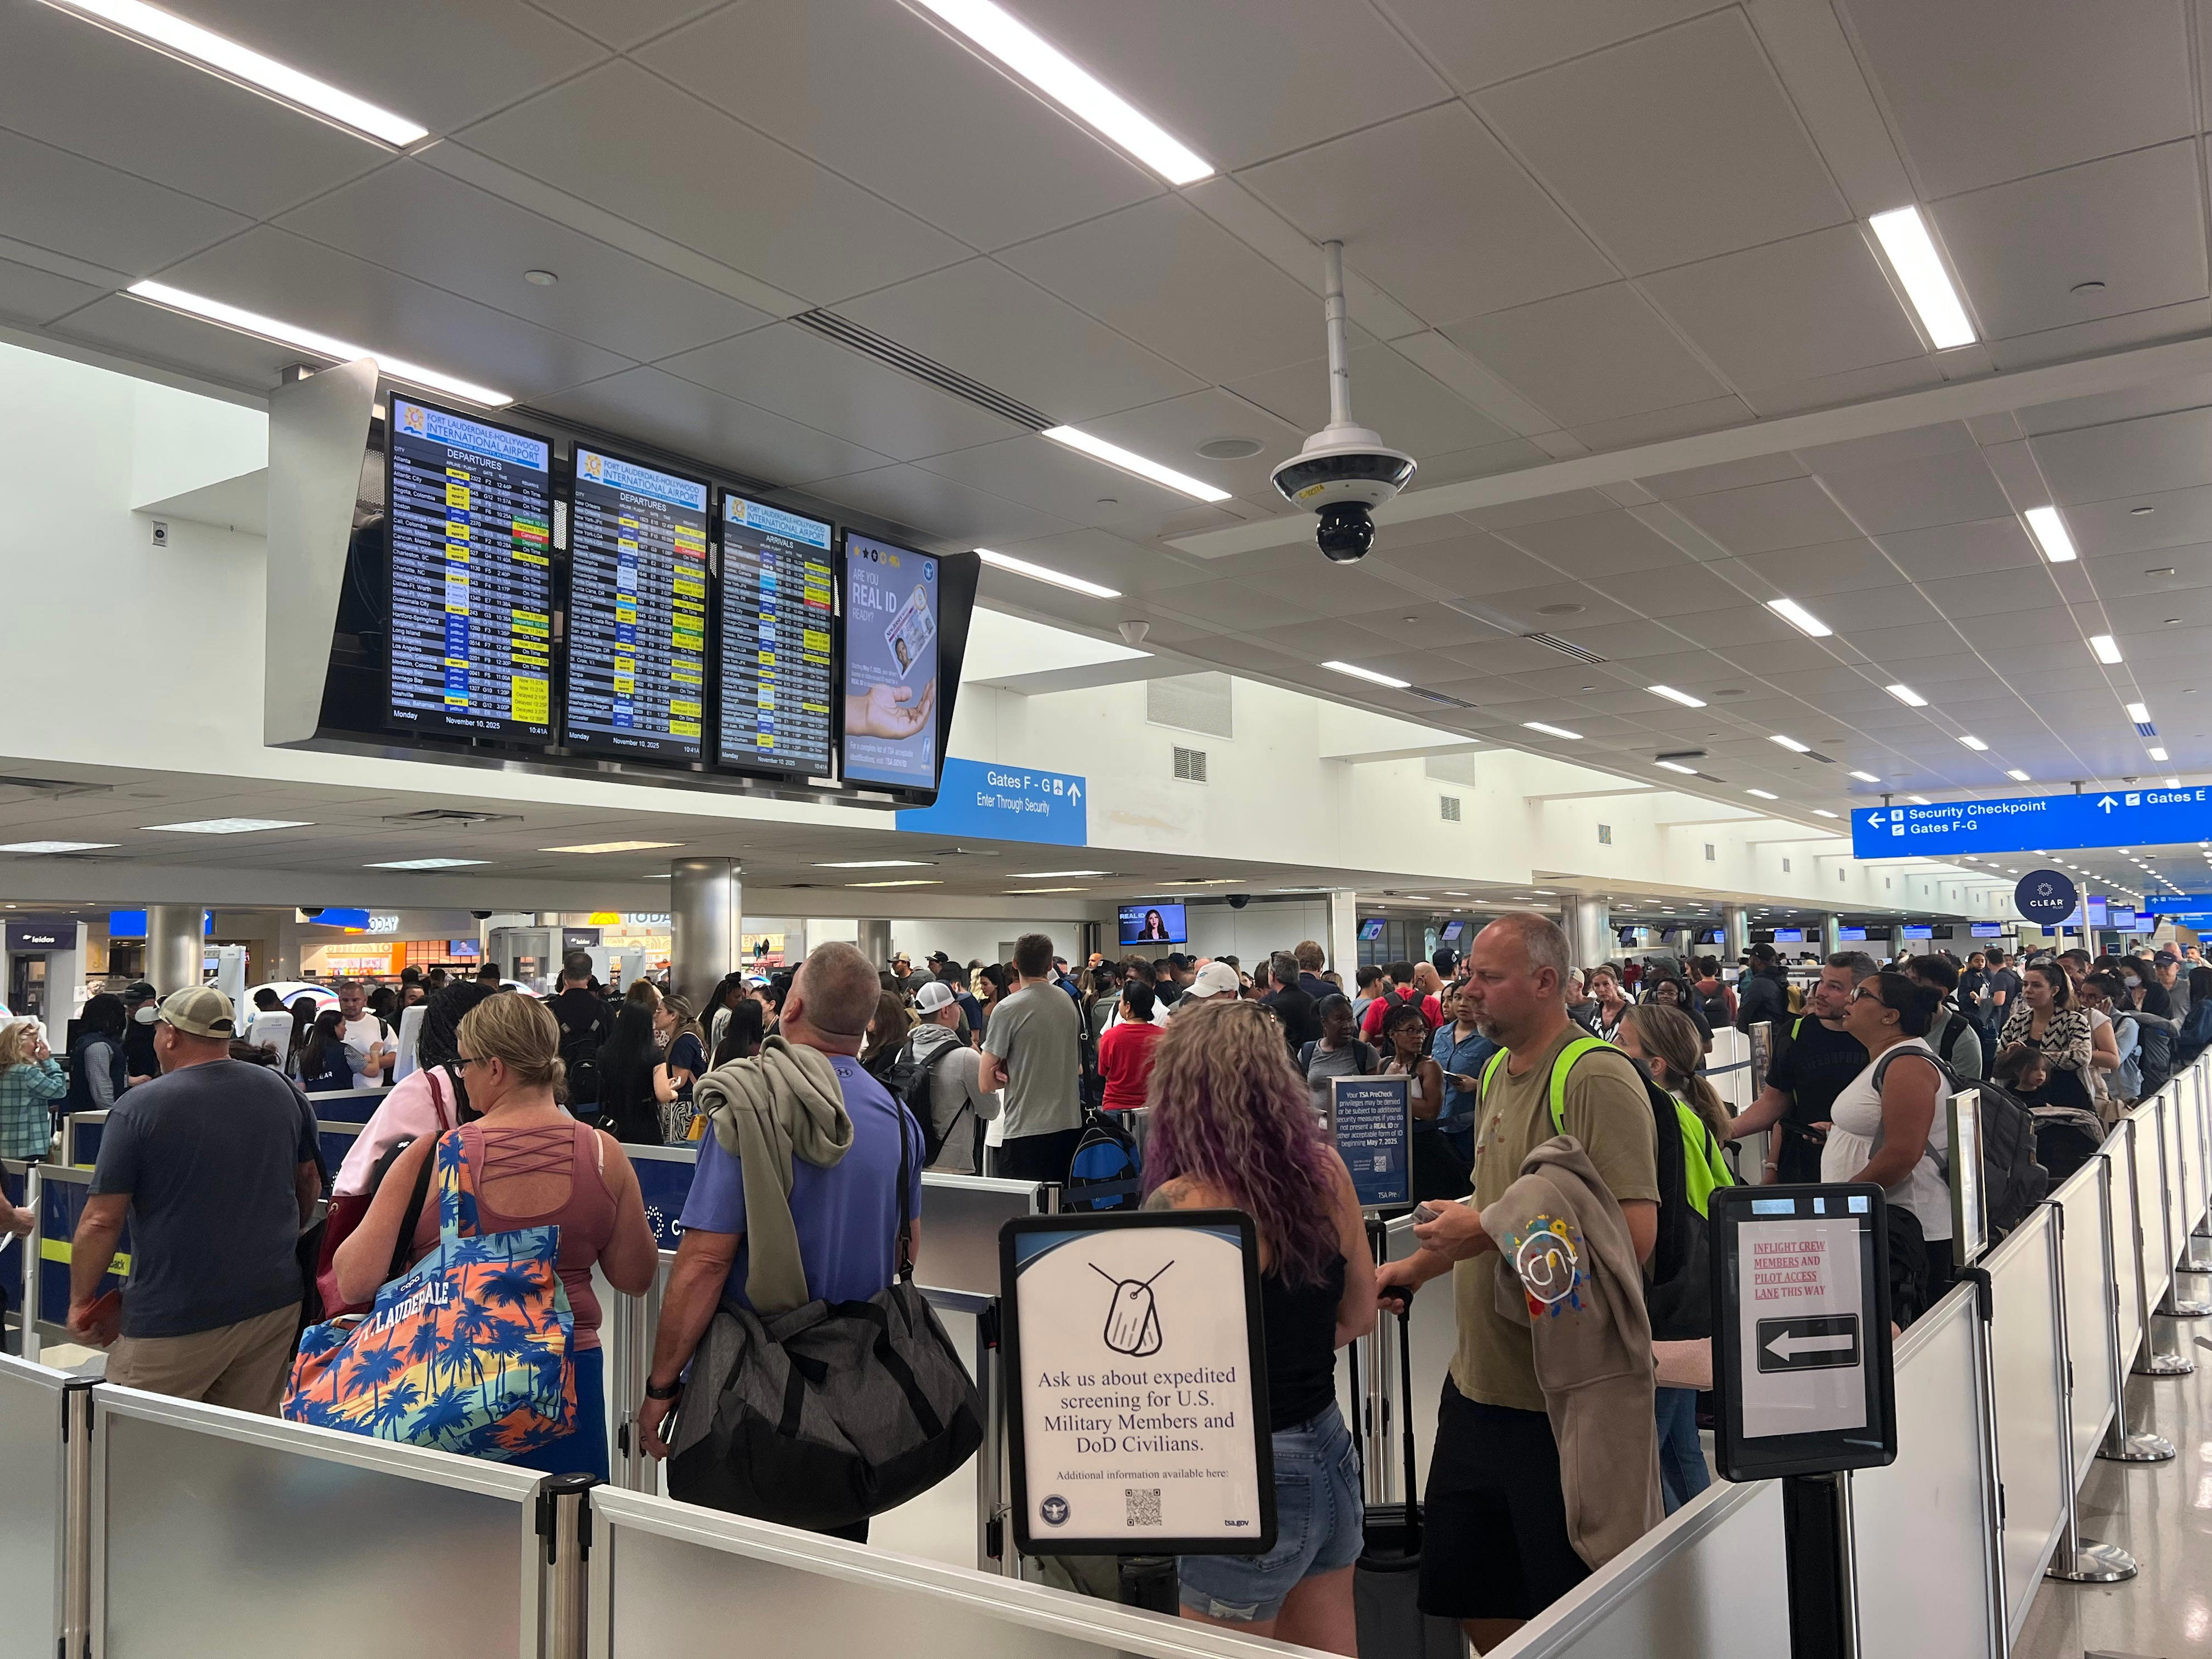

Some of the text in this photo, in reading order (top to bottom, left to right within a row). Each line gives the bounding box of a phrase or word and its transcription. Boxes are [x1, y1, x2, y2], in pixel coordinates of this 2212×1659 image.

[427, 413, 539, 452] FORT LAUDERDALE-HOLLYWOOD
[427, 423, 539, 461] INTERNATIONAL AIRPORT
[447, 448, 502, 470] DEPARTURES
[394, 471, 411, 480] Atlantic
[604, 460, 620, 469] FORT
[621, 465, 700, 494] LAUDERDALE-HOLLYWOOD
[604, 469, 666, 494] INTERNATIONAL
[668, 488, 698, 503] AIRPORT
[620, 492, 667, 512] DEPARTURES
[747, 504, 825, 533] FORT LAUDERDALE-HOLLYWOOD
[747, 513, 798, 534] INTERNATIONAL
[799, 529, 825, 541] AIRPORT
[766, 534, 793, 549] ARRIVALS
[853, 568, 879, 585] ARE YOU
[852, 582, 897, 613] REAL ID
[852, 607, 874, 623] READY?
[394, 710, 418, 720] Monday
[446, 716, 475, 726] November
[569, 732, 590, 741] Monday
[613, 737, 638, 747] November
[722, 751, 739, 760] Monday
[987, 771, 1021, 789] Gates
[1024, 776, 1031, 789] F
[1042, 778, 1050, 792] G
[977, 792, 1049, 817] Enter Through Security
[2147, 790, 2206, 804] Gates E
[1909, 801, 2046, 819] Security Checkpoint
[1910, 820, 1977, 834] Gates F-G
[2030, 899, 2063, 907] CLEAR
[368, 917, 398, 932] ODAY
[1754, 1241, 1825, 1253] INFLIGHT CREW
[1754, 1256, 1820, 1268] MEMBERS AND
[1755, 1271, 1816, 1283] PILOT ACCESS
[1755, 1286, 1825, 1299] LANE THIS WAY
[1038, 1367, 1236, 1388] Ask us about expedited
[1061, 1390, 1214, 1411] screening for U.S.
[1044, 1412, 1235, 1434] Military Members and
[1077, 1435, 1204, 1453] DoD Civilians.
[1057, 1469, 1229, 1480] Additional information available here:
